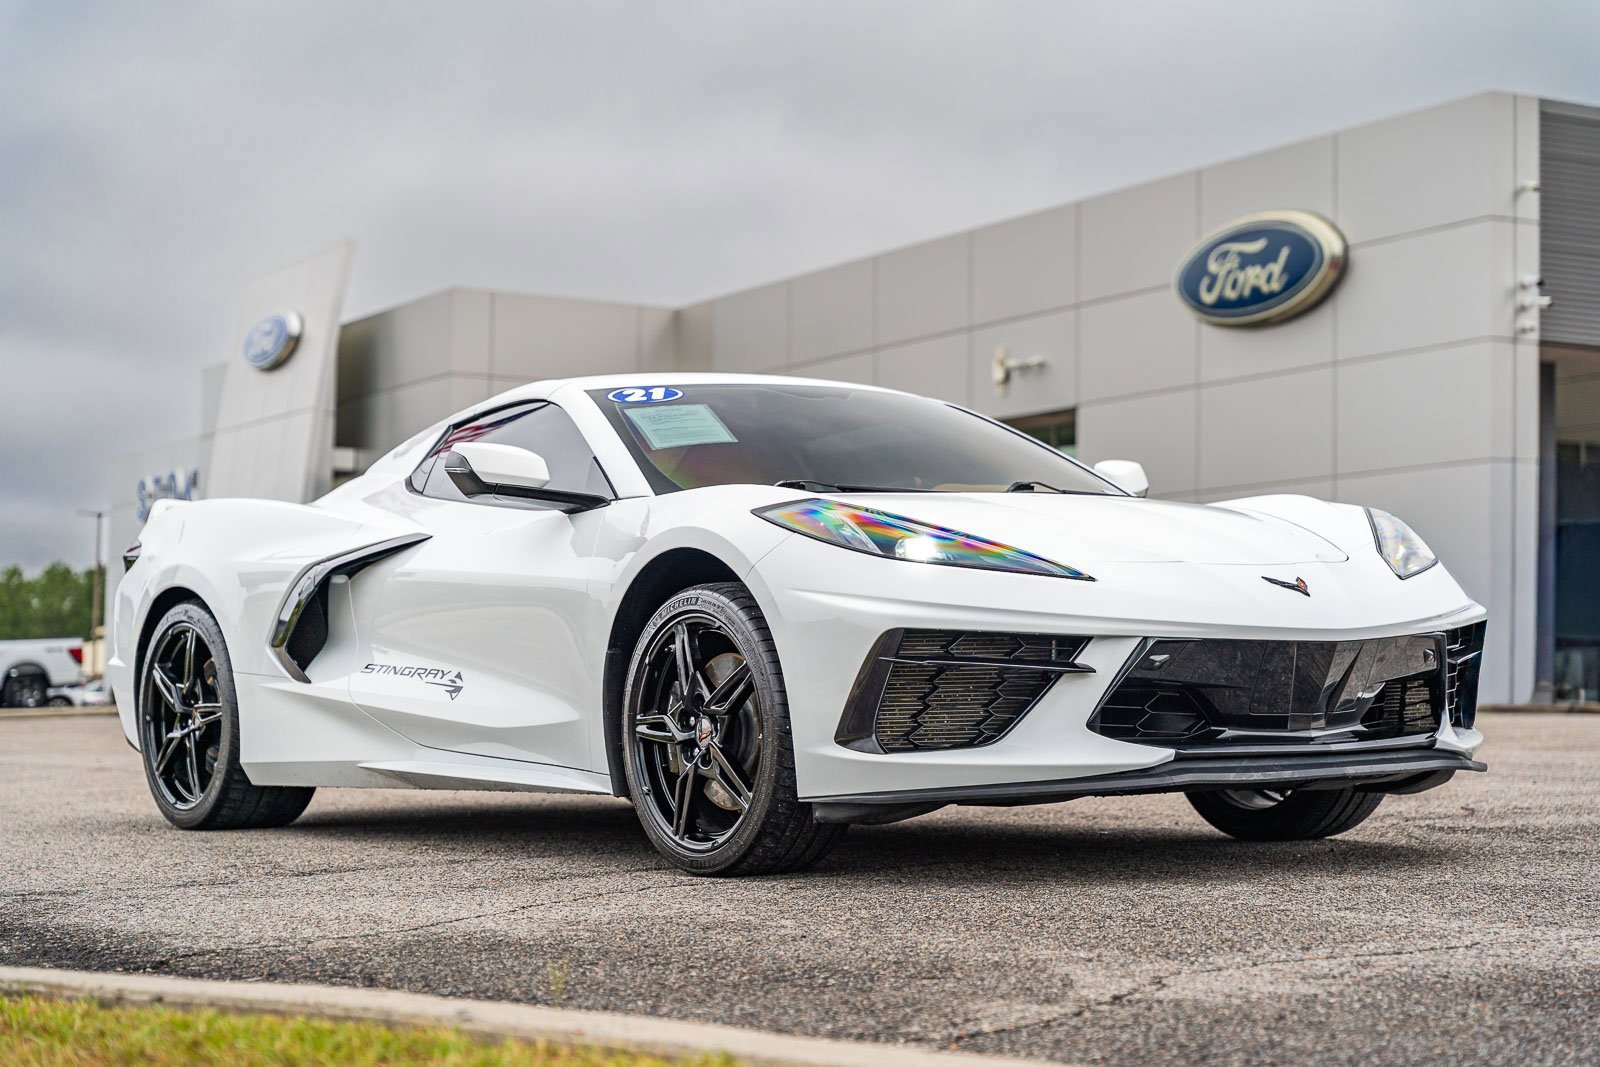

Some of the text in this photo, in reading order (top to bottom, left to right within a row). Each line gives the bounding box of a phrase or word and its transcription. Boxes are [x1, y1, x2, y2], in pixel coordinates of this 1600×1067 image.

[1199, 237, 1290, 304] Ford
[622, 387, 666, 402] 21
[661, 597, 698, 617] MICHELIN
[360, 663, 452, 680] STINGRAY
